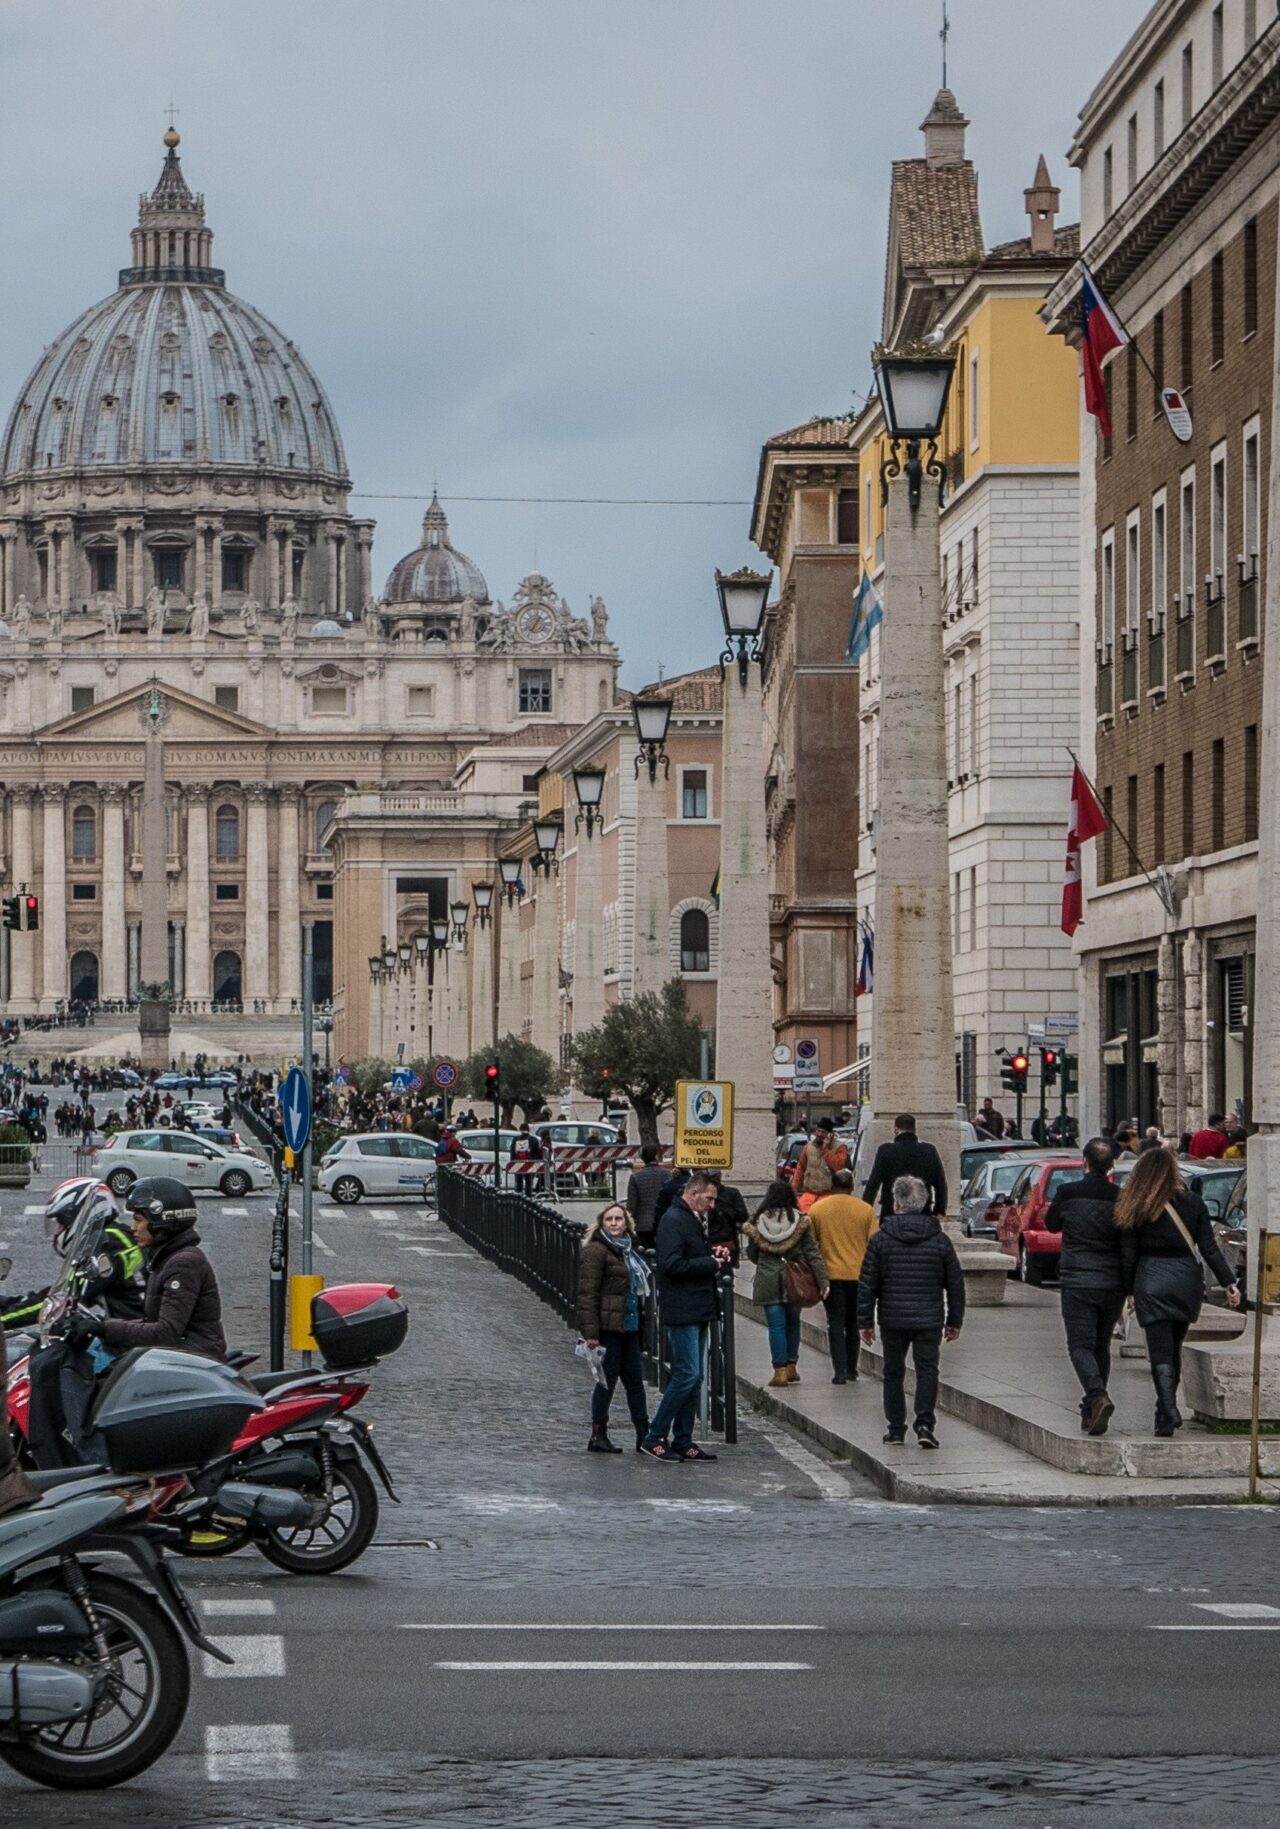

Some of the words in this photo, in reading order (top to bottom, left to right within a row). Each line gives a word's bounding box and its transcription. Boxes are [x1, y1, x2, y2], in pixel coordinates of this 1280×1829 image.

[1, 752, 42, 763] APOST
[195, 751, 267, 762] ROMANVS
[683, 1129, 724, 1137] PERCORSO
[683, 1138, 724, 1147] PEDONALE
[696, 1148, 711, 1156] DEL
[680, 1157, 727, 1165] PELLEGRINO
